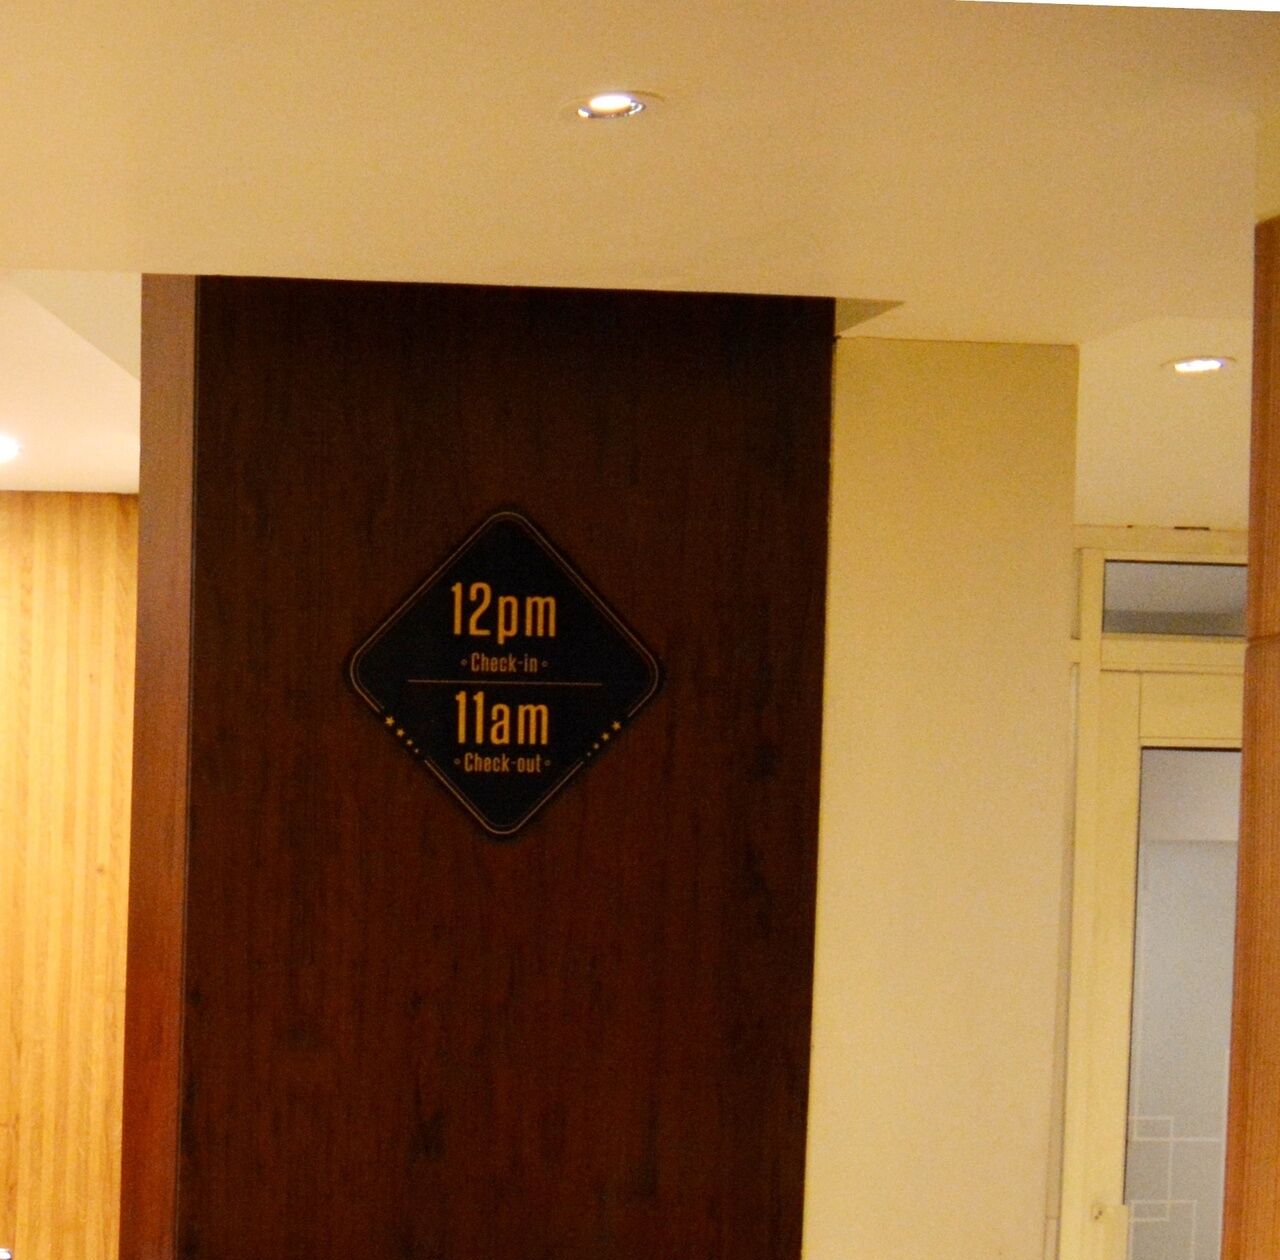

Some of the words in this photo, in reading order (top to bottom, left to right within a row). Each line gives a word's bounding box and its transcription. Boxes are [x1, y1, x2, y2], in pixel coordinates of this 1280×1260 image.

[450, 582, 556, 645] 12pm
[470, 652, 538, 673] Check-in
[455, 691, 548, 745] 11am
[464, 752, 541, 773] Check-out
